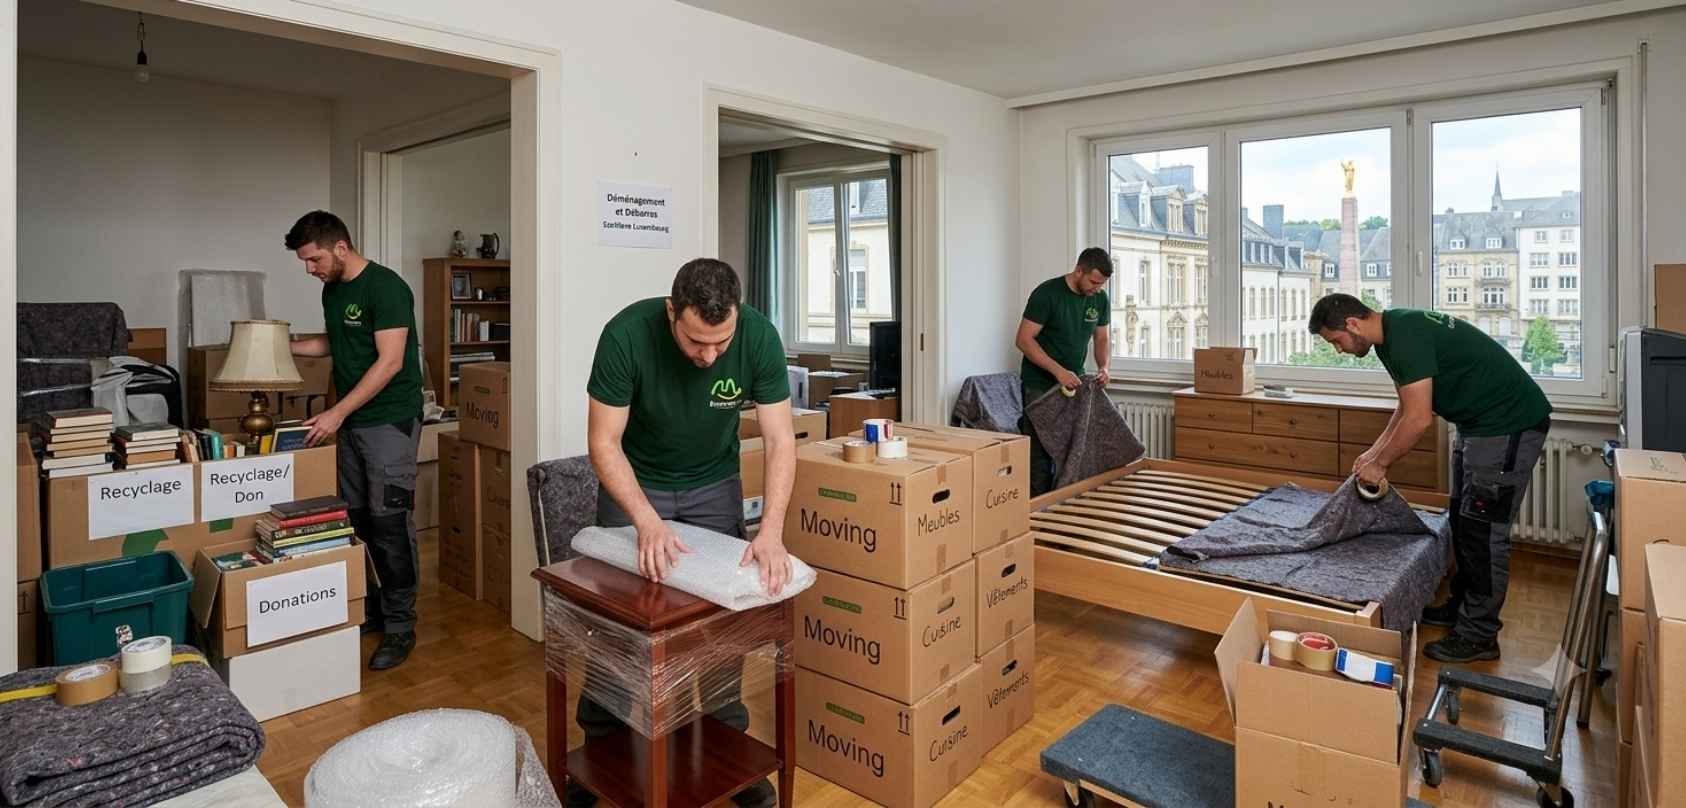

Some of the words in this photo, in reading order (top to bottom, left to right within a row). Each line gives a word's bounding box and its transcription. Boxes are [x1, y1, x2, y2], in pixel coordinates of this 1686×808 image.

[615, 208, 624, 216] et
[466, 401, 500, 428] Moving
[210, 463, 291, 486] Recyclage/
[100, 480, 182, 500] Recyclage
[235, 490, 264, 504] Don
[801, 508, 877, 553] Moving
[917, 509, 960, 537] Meubles
[259, 586, 337, 614] Donations
[804, 615, 881, 665] Moving
[808, 719, 885, 778] Moving
